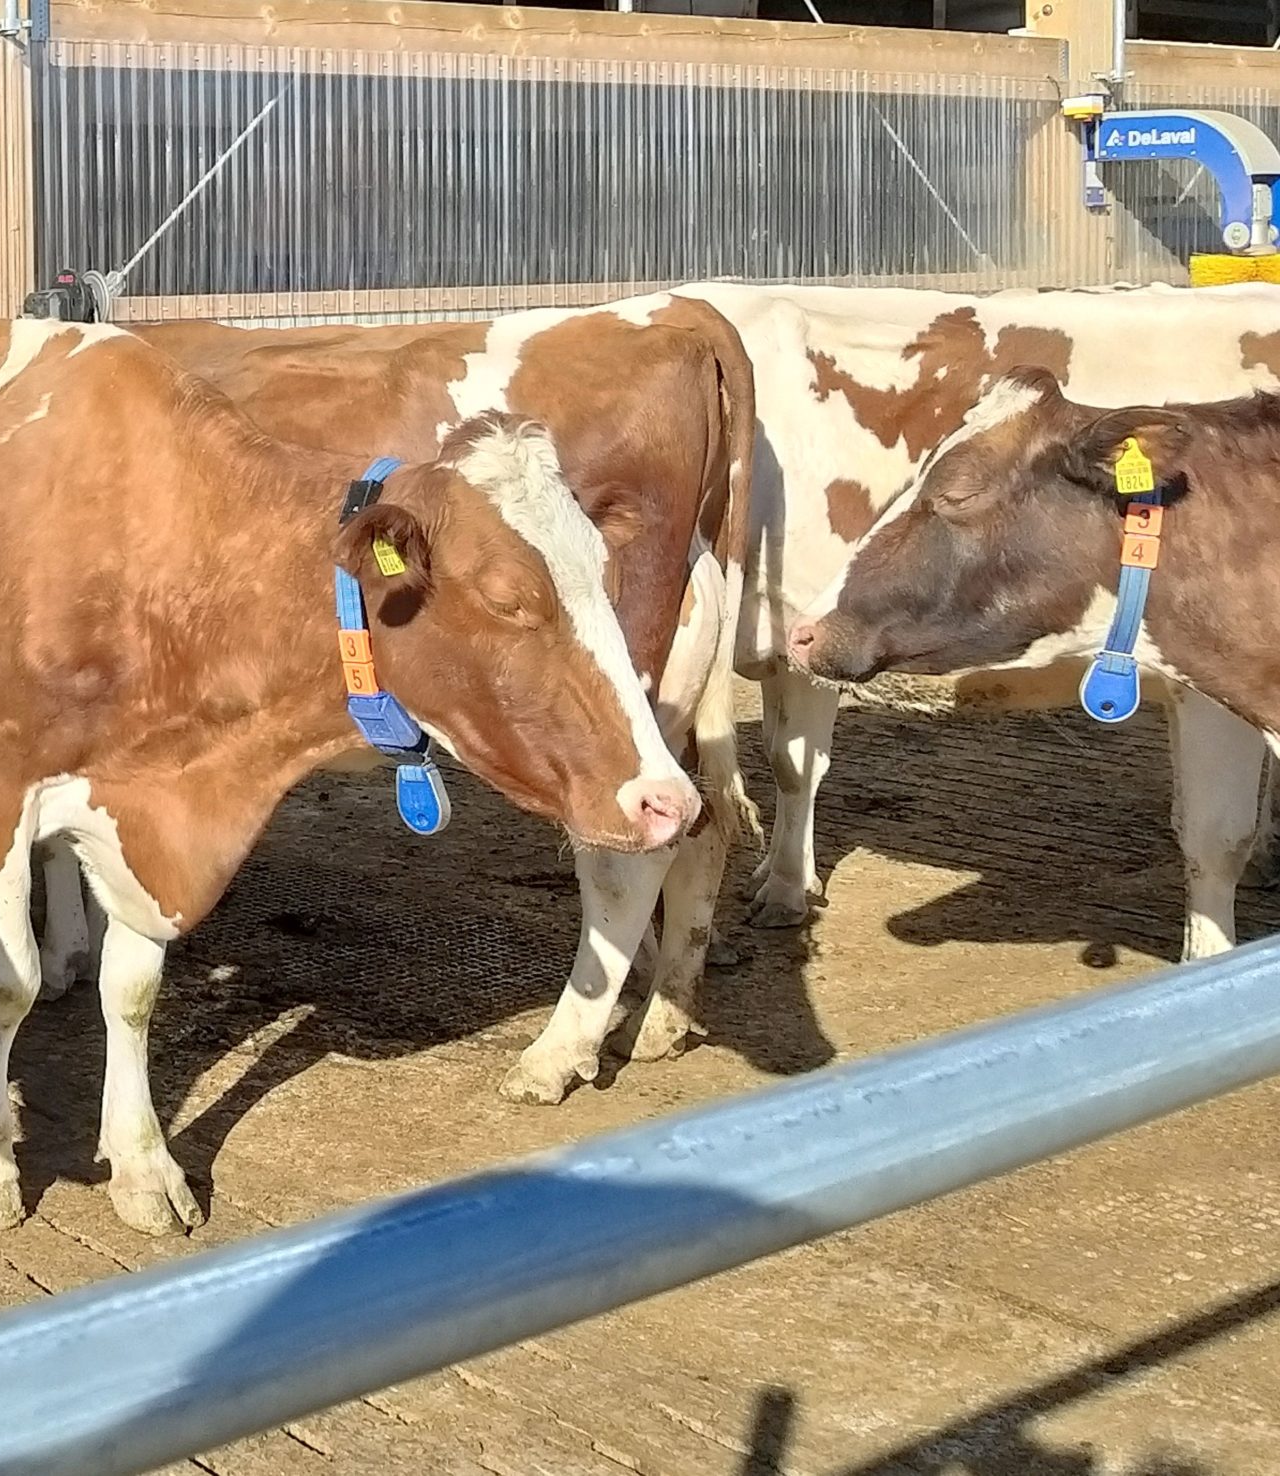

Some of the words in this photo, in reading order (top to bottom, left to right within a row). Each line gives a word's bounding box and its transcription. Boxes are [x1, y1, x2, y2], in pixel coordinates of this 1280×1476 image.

[1127, 128, 1196, 147] DeLaval
[1137, 508, 1151, 529] 3
[1131, 543, 1144, 561] 4
[346, 636, 357, 657] 3
[351, 669, 363, 689] 5
